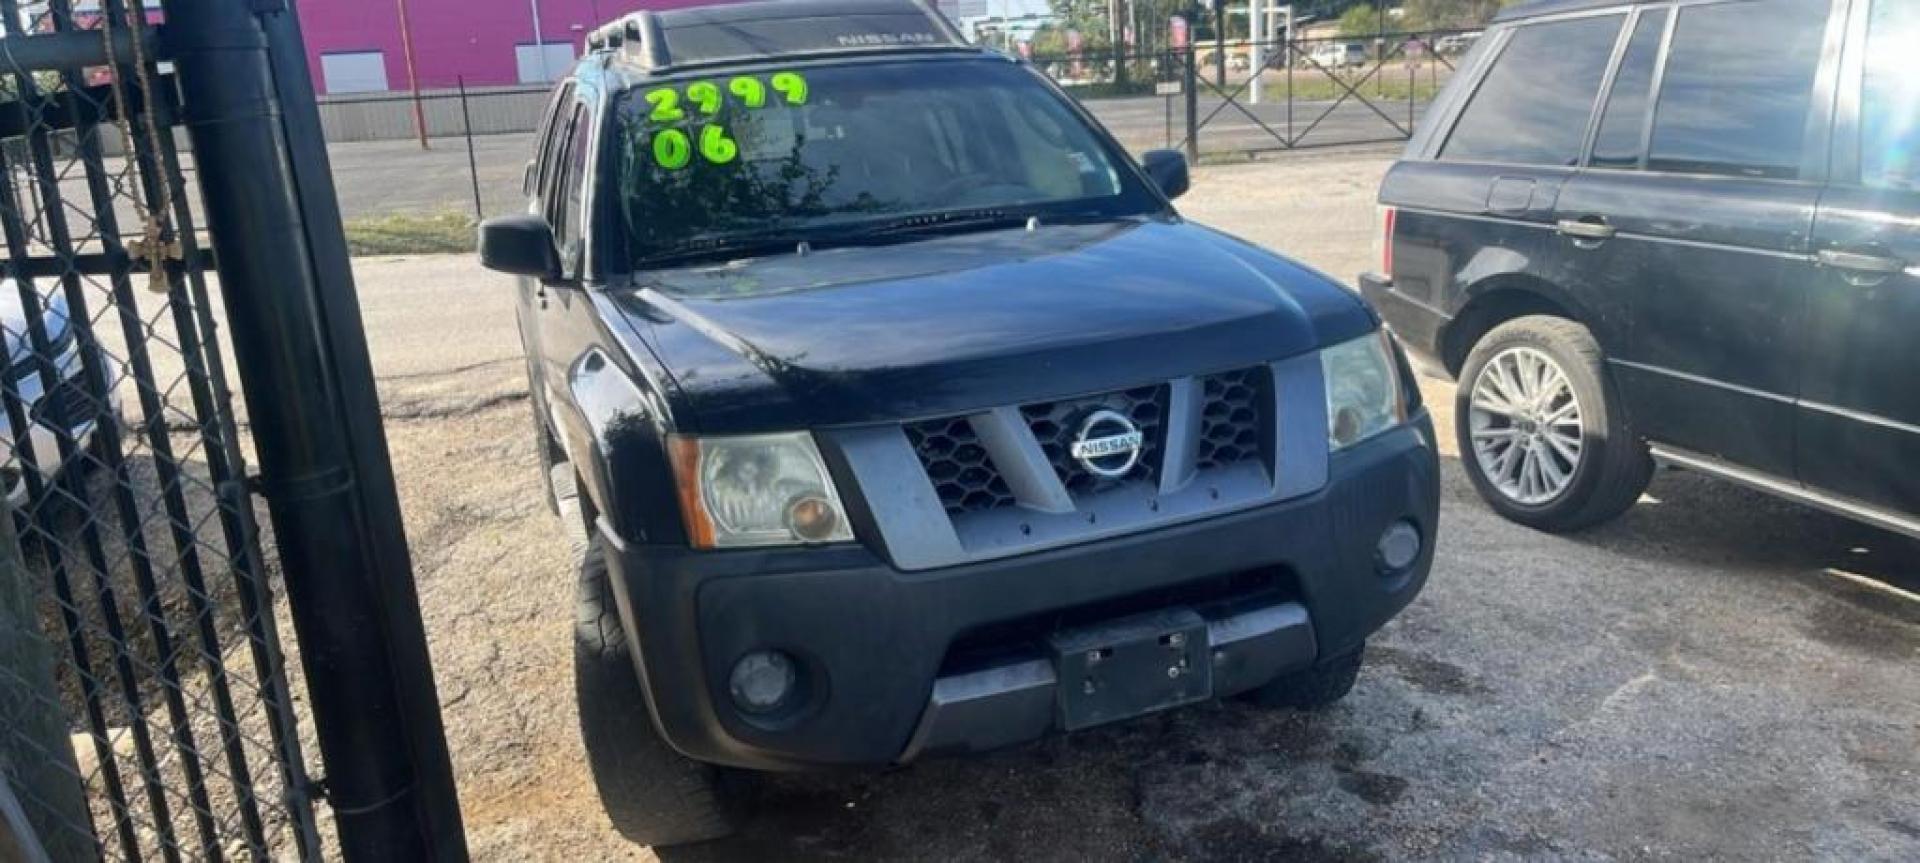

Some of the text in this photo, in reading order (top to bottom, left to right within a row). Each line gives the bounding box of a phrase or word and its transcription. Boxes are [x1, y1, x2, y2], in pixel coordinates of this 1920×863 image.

[837, 32, 934, 47] NISSAN
[644, 72, 808, 121] 2999
[653, 124, 736, 169] 06
[1080, 435, 1140, 454] NISSAN
